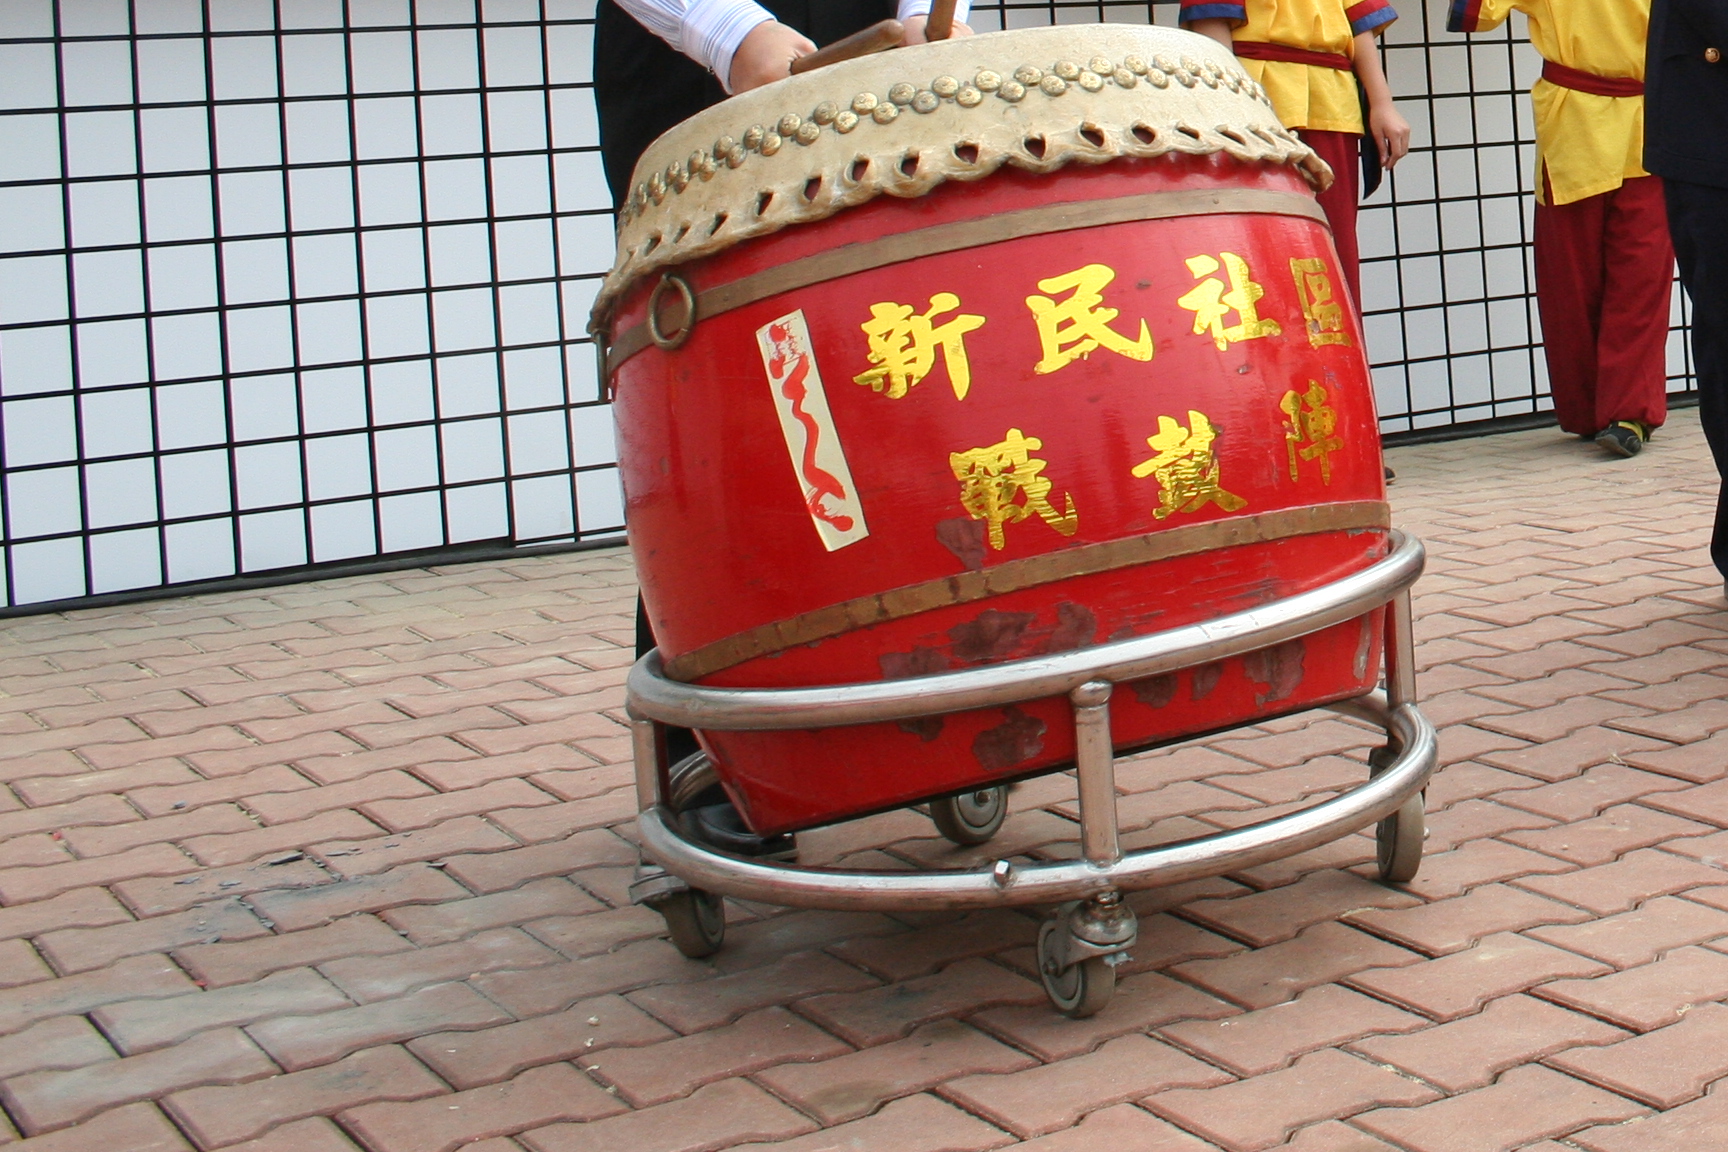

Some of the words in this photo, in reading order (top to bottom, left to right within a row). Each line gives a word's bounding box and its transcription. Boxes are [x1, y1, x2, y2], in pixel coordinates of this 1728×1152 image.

[853, 251, 1352, 401] 新民社區
[949, 378, 1344, 551] 戰鼓陣
